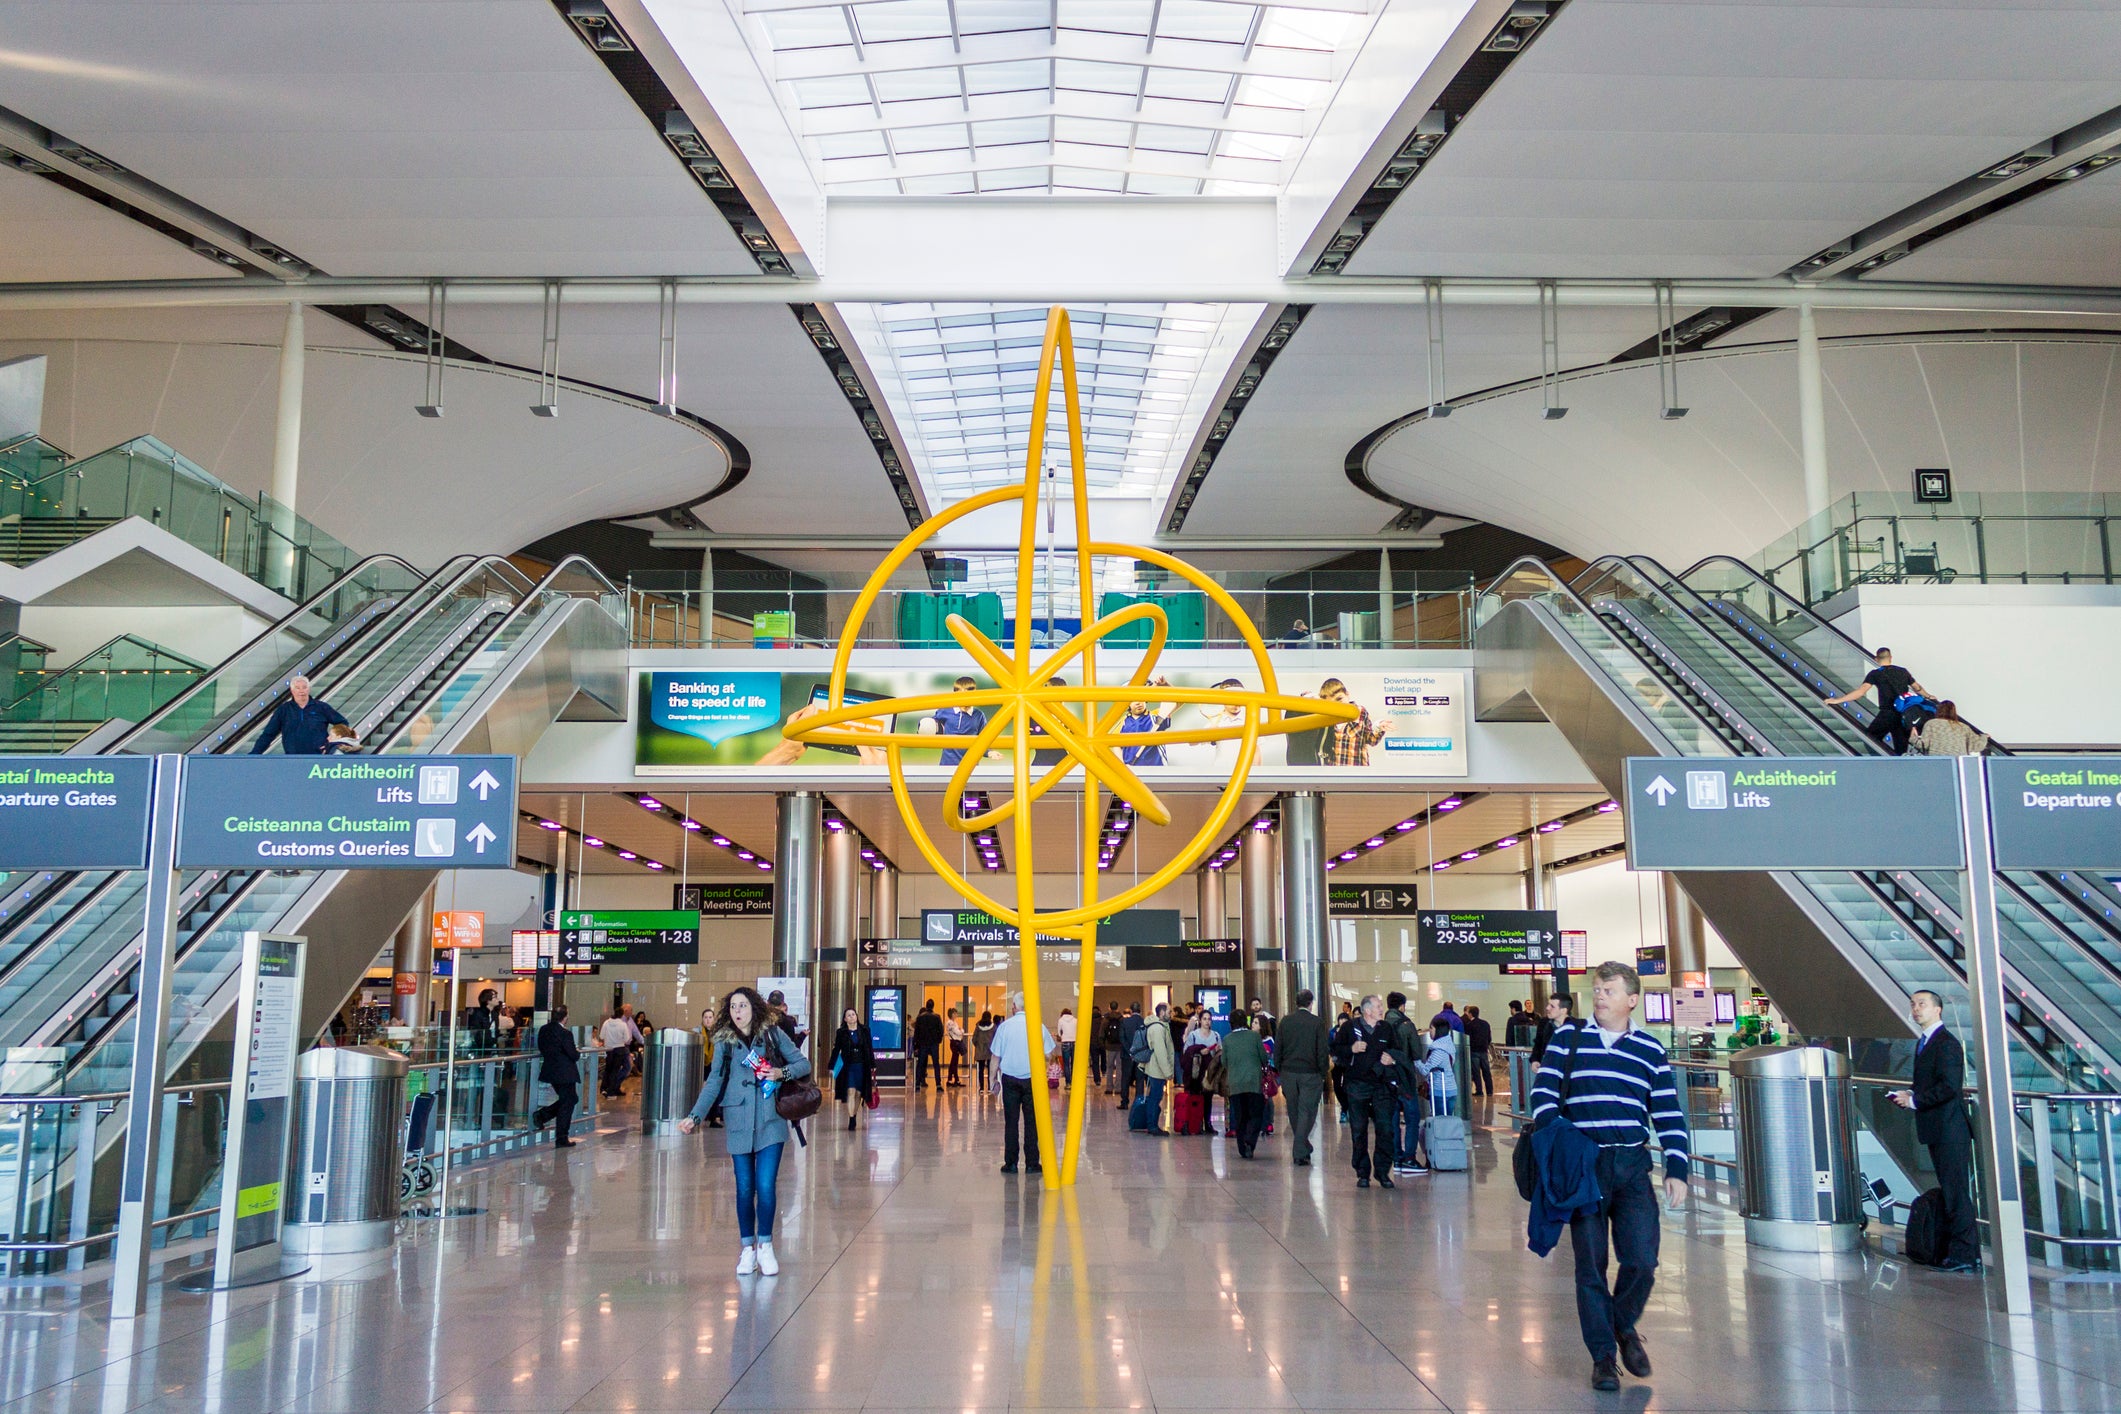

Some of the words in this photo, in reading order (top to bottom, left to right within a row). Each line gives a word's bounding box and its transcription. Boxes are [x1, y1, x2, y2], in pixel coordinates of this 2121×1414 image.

[669, 682, 720, 695] Banking
[722, 683, 735, 693] at
[668, 696, 689, 708] the
[692, 696, 730, 709] speed
[732, 696, 745, 707] of
[748, 696, 766, 708] life
[34, 768, 115, 784] Imeachta
[308, 763, 416, 779] Ardaitheoirí
[1733, 770, 1838, 786] Ardaitheoirí
[2025, 769, 2083, 785] Geataí
[2087, 770, 2121, 785] Ime
[65, 790, 117, 806] Gates
[376, 787, 413, 803] Lifts
[1733, 792, 1771, 808] Lifts
[2023, 791, 2113, 811] Departure
[224, 817, 323, 832] Ceisteanna
[327, 816, 411, 832] Chustaim
[257, 840, 335, 857] Customs
[339, 840, 410, 857] Queries
[704, 889, 731, 899] Ionad
[733, 888, 764, 899] Coinní
[704, 900, 742, 911] Meeting
[746, 900, 771, 910] Point
[957, 913, 989, 925] Eitiltí
[660, 930, 692, 944] 1-28
[957, 929, 1004, 941] Arrivals
[1437, 930, 1477, 944] 29-56
[892, 958, 911, 966] ATM
